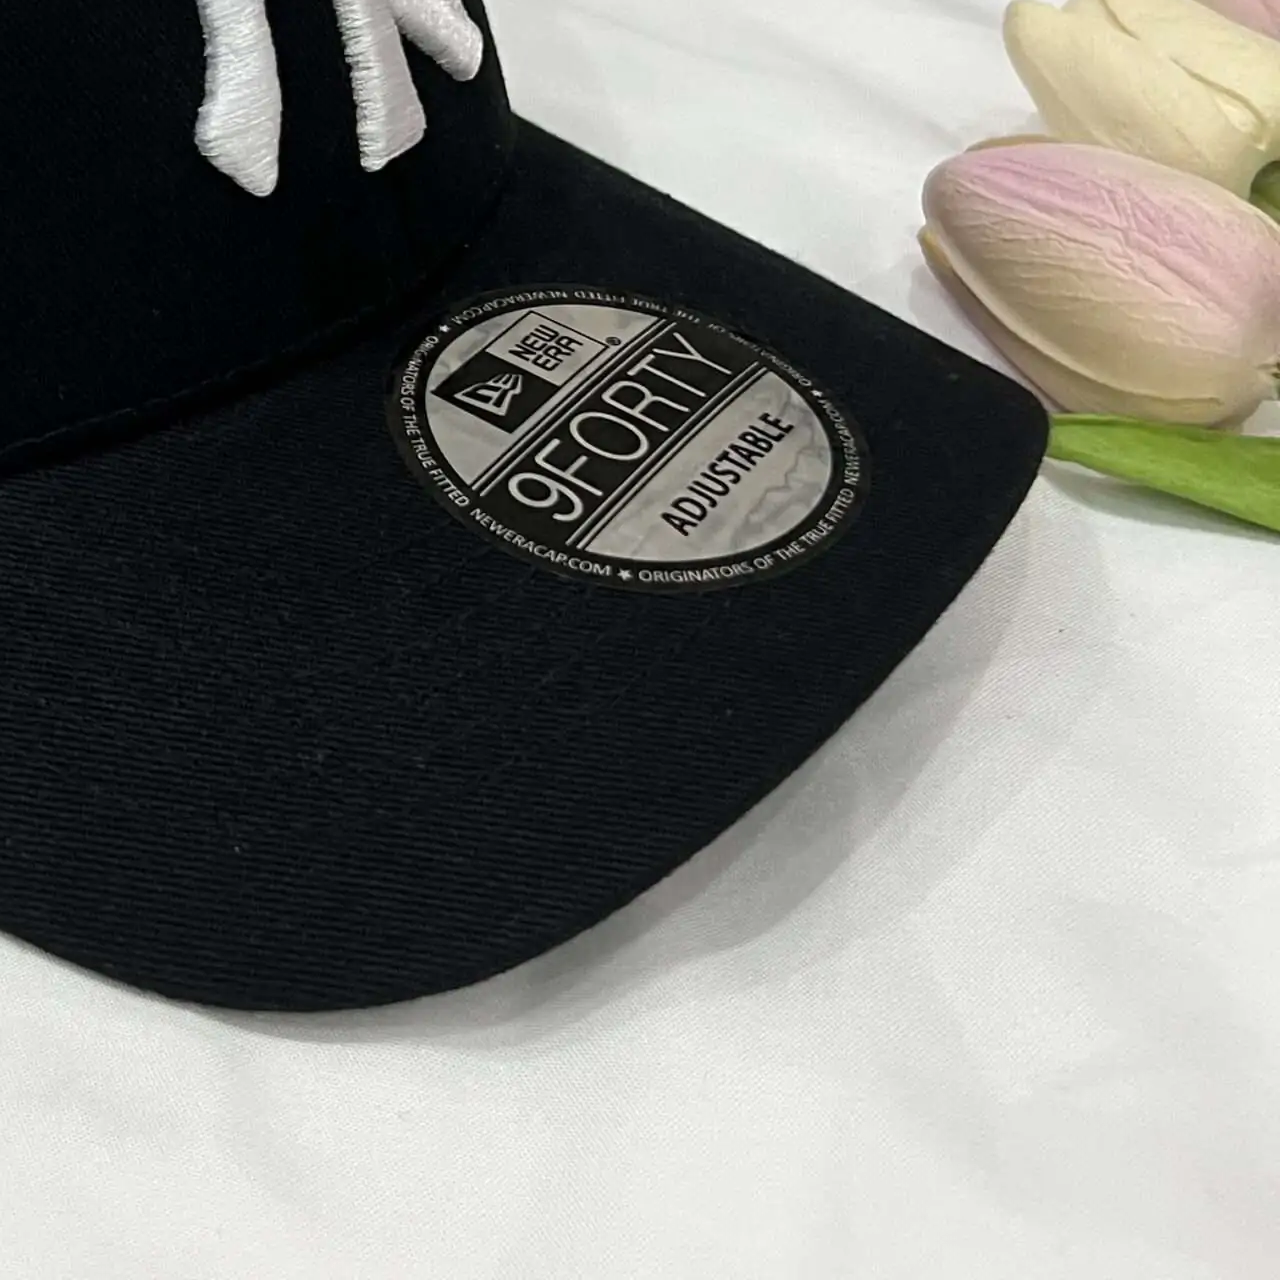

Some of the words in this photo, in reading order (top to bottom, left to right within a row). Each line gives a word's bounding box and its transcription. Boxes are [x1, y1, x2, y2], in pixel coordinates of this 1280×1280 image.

[508, 324, 560, 362] NEW
[531, 335, 584, 372] ERA
[400, 335, 440, 397] ORIGINATORS
[400, 398, 417, 415] OF
[402, 414, 421, 437] THE
[507, 331, 733, 523] 9FORTY
[410, 436, 438, 469] TRUE
[429, 468, 471, 508] FITTED
[660, 411, 796, 537] ADJUSTABLE
[470, 507, 613, 577] NEWERACAP.COM
[638, 560, 755, 584] ORIGINATORS
[753, 554, 775, 570] OF
[775, 540, 807, 561] THE
[798, 519, 835, 547] TRUE
[824, 487, 856, 524] FITTED
